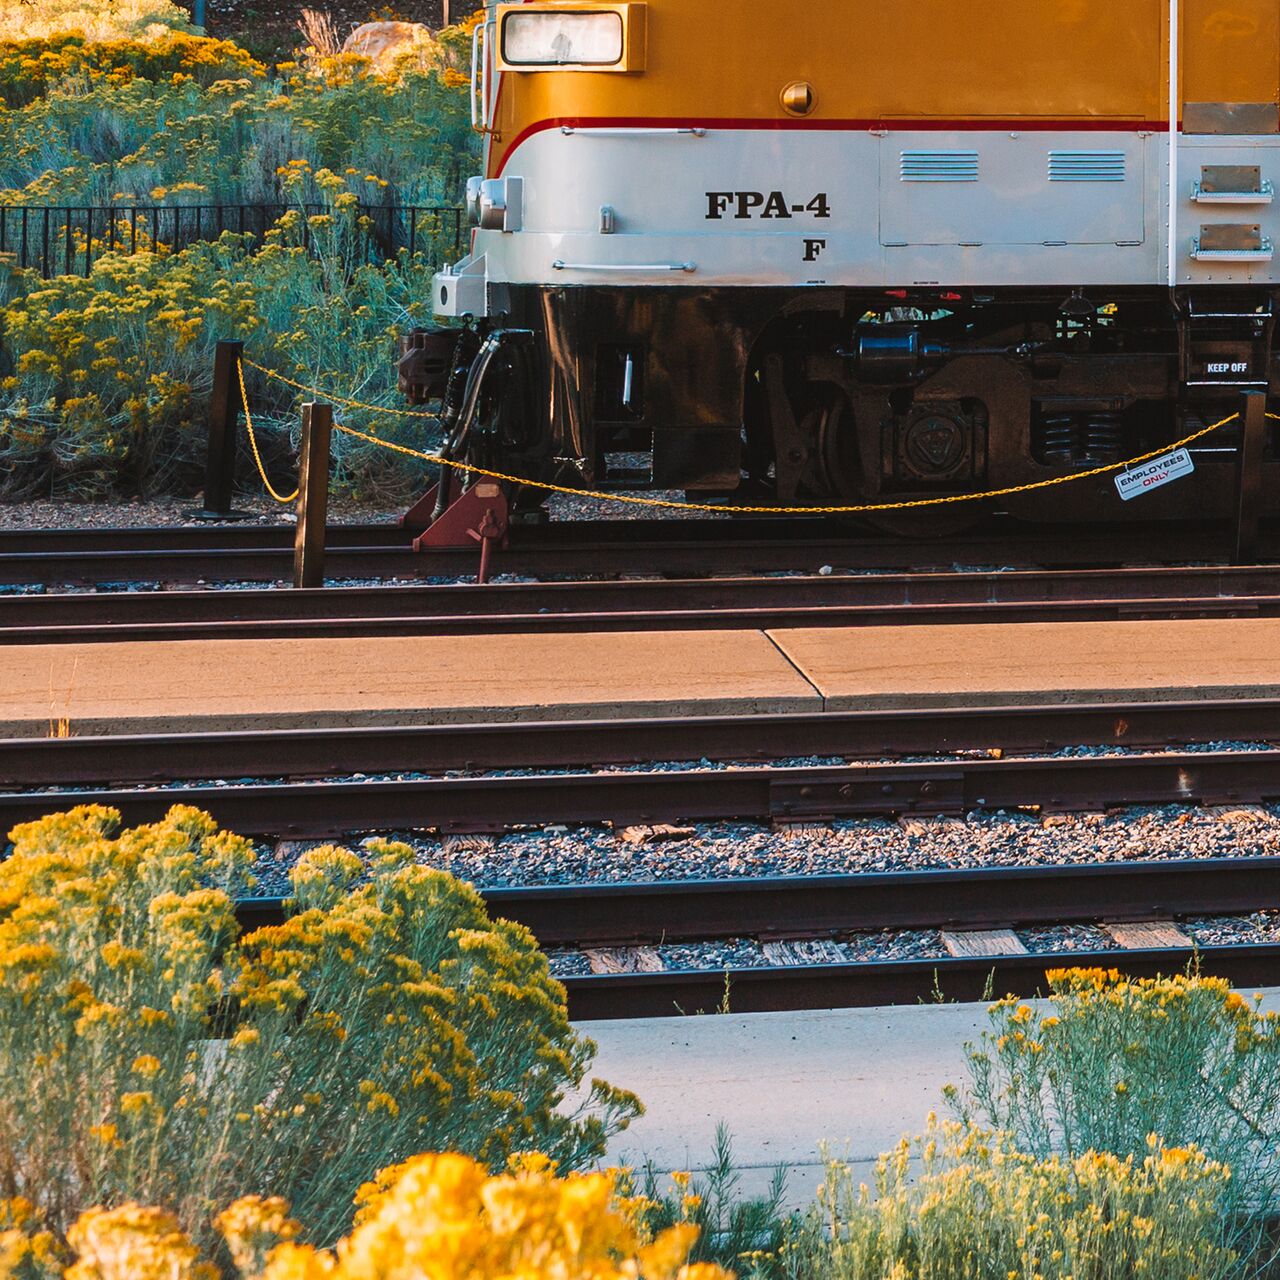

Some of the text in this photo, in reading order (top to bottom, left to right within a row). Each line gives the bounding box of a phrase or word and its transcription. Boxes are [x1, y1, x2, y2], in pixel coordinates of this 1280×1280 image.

[705, 191, 831, 219] FPA-4
[802, 239, 826, 261] F
[1207, 362, 1247, 373] KEEP OFF
[1121, 455, 1185, 486] EMPLOYEES
[1142, 470, 1170, 487] ONLY
